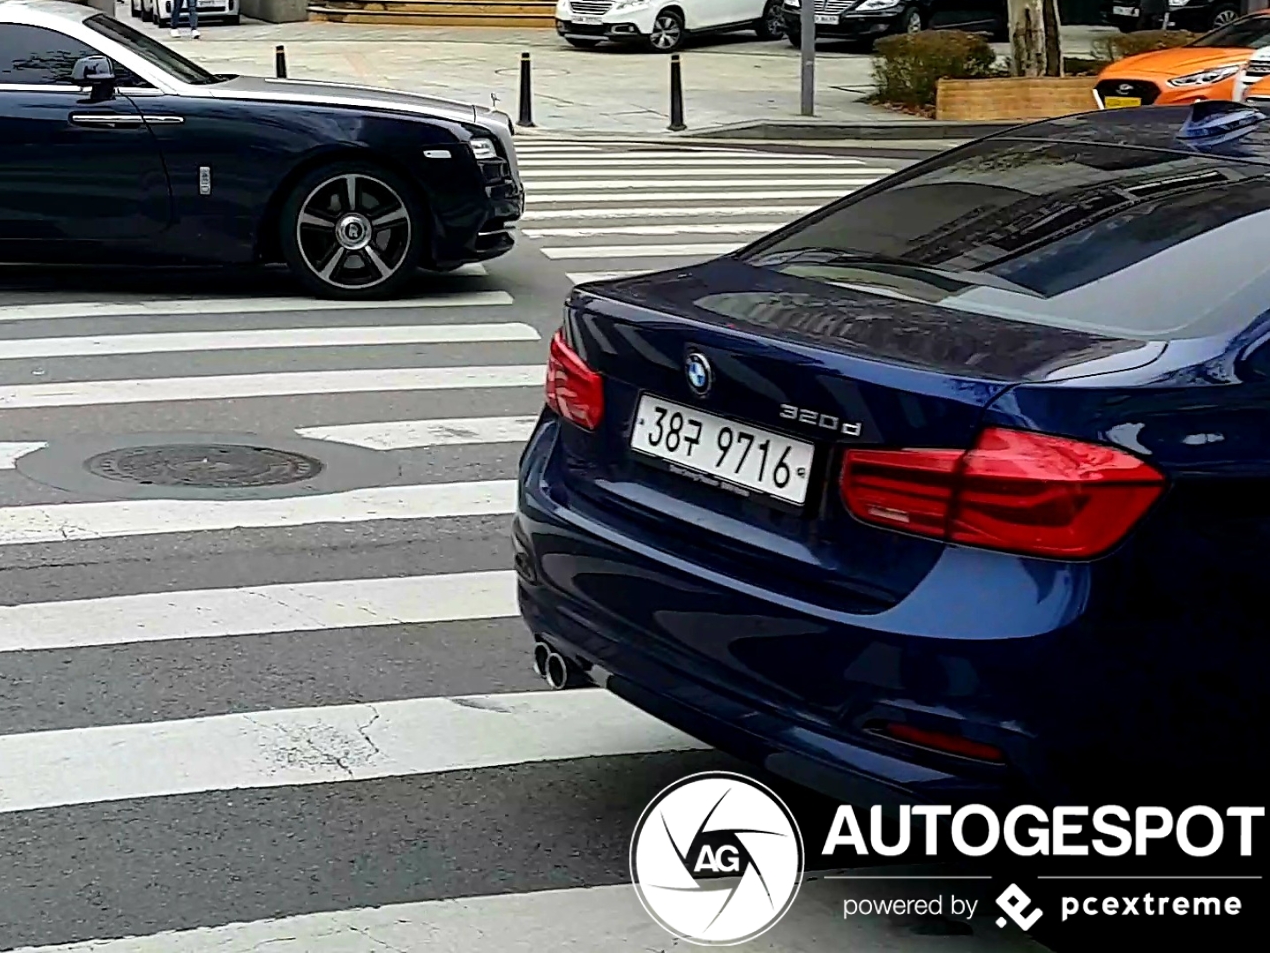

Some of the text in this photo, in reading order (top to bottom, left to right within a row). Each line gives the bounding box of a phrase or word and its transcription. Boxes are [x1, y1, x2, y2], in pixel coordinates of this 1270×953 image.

[648, 406, 703, 456] 38구
[716, 426, 790, 489] 9716
[779, 403, 862, 437] 320d
